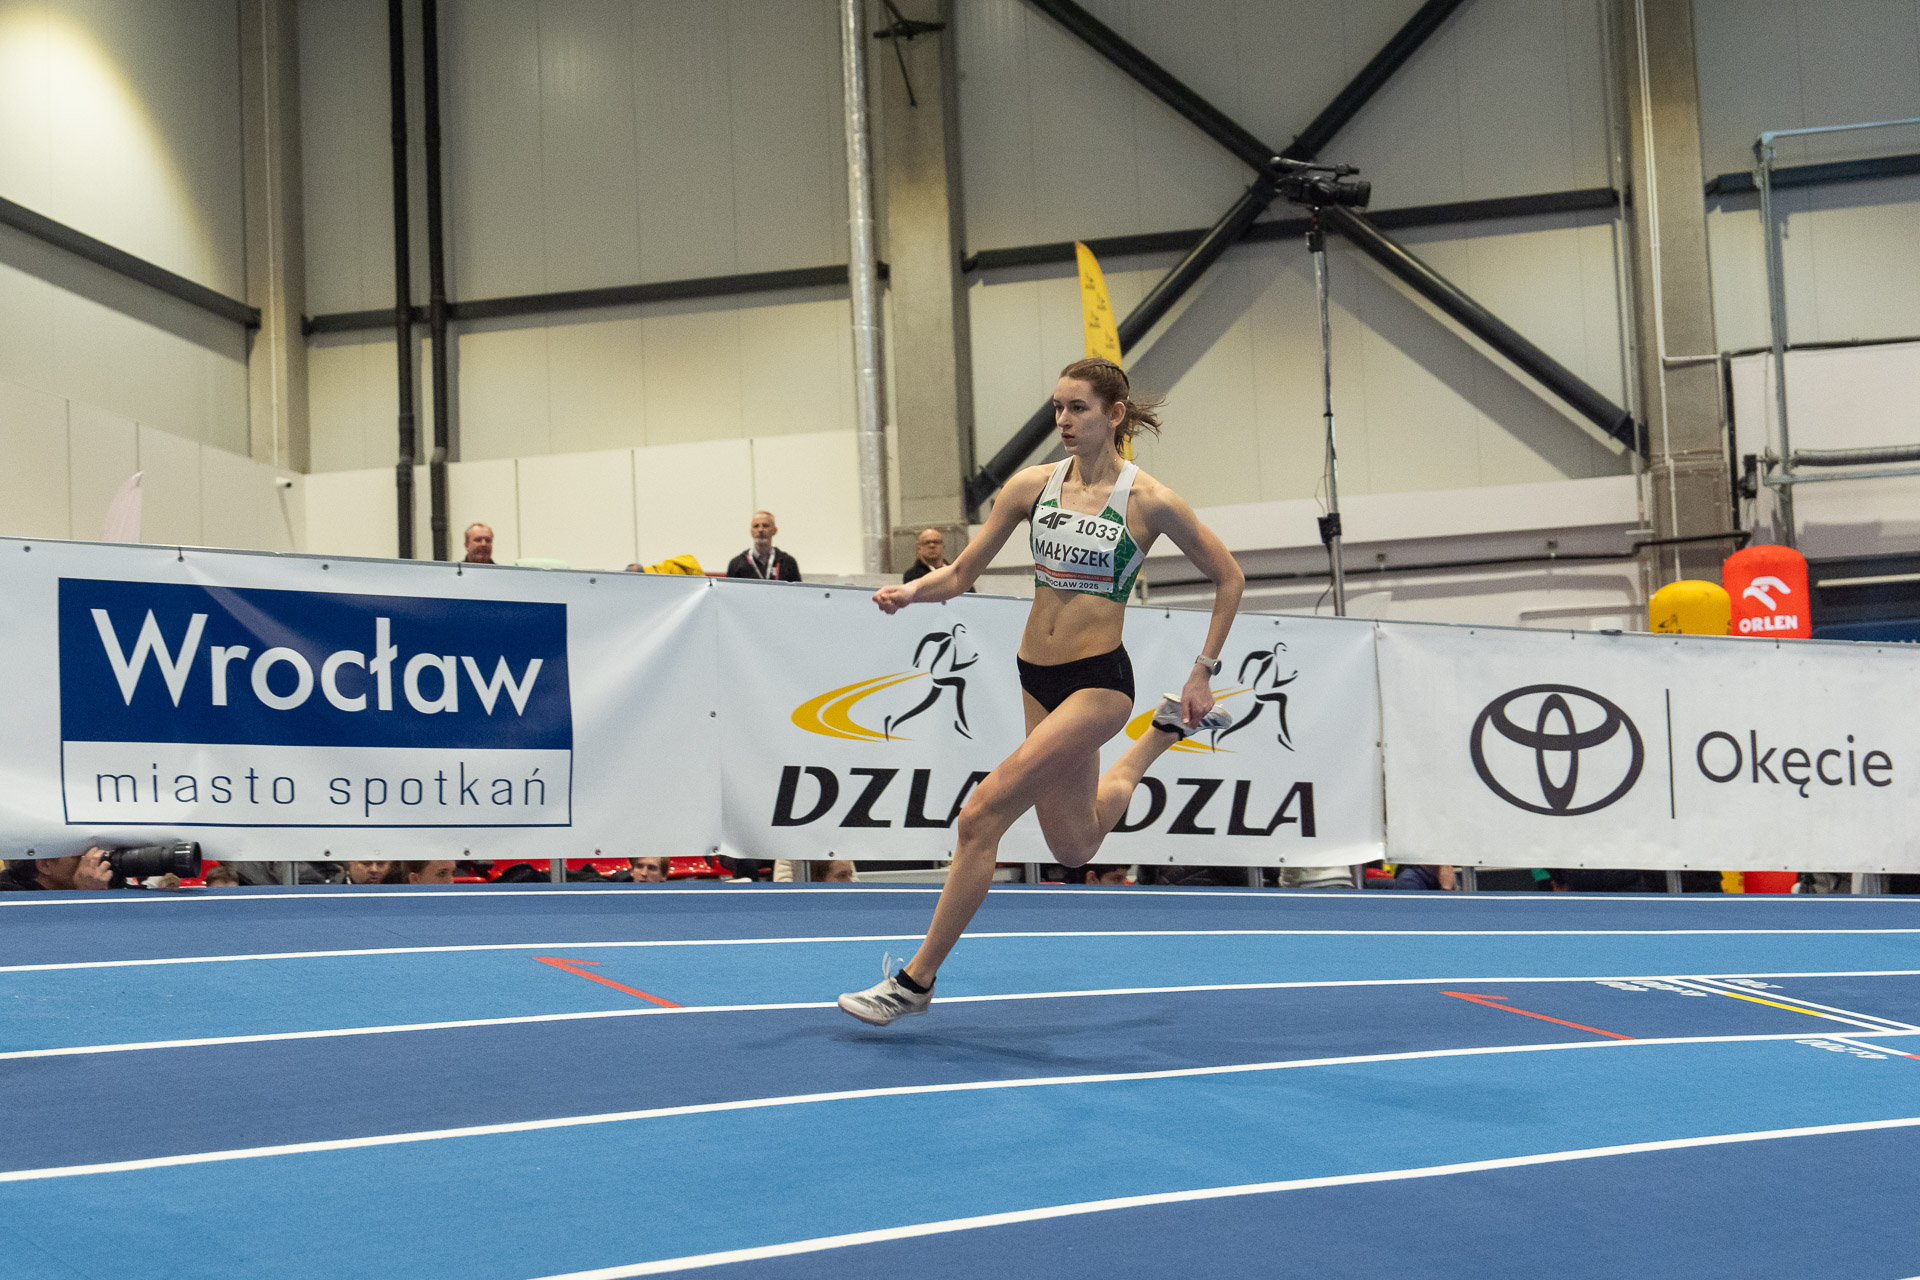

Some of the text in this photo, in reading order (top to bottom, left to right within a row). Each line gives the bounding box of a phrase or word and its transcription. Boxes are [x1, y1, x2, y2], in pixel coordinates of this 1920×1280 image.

[1075, 519, 1119, 542] 1033
[1035, 538, 1110, 568] MAŁYSZEK
[1045, 575, 1099, 590] OCŁAW 2025
[1739, 614, 1798, 634] ORLEN
[90, 609, 544, 716] Wrocław
[1697, 730, 1894, 798] Okęcie
[97, 762, 546, 817] miasto spotkań
[1110, 776, 1317, 837] DZLA
